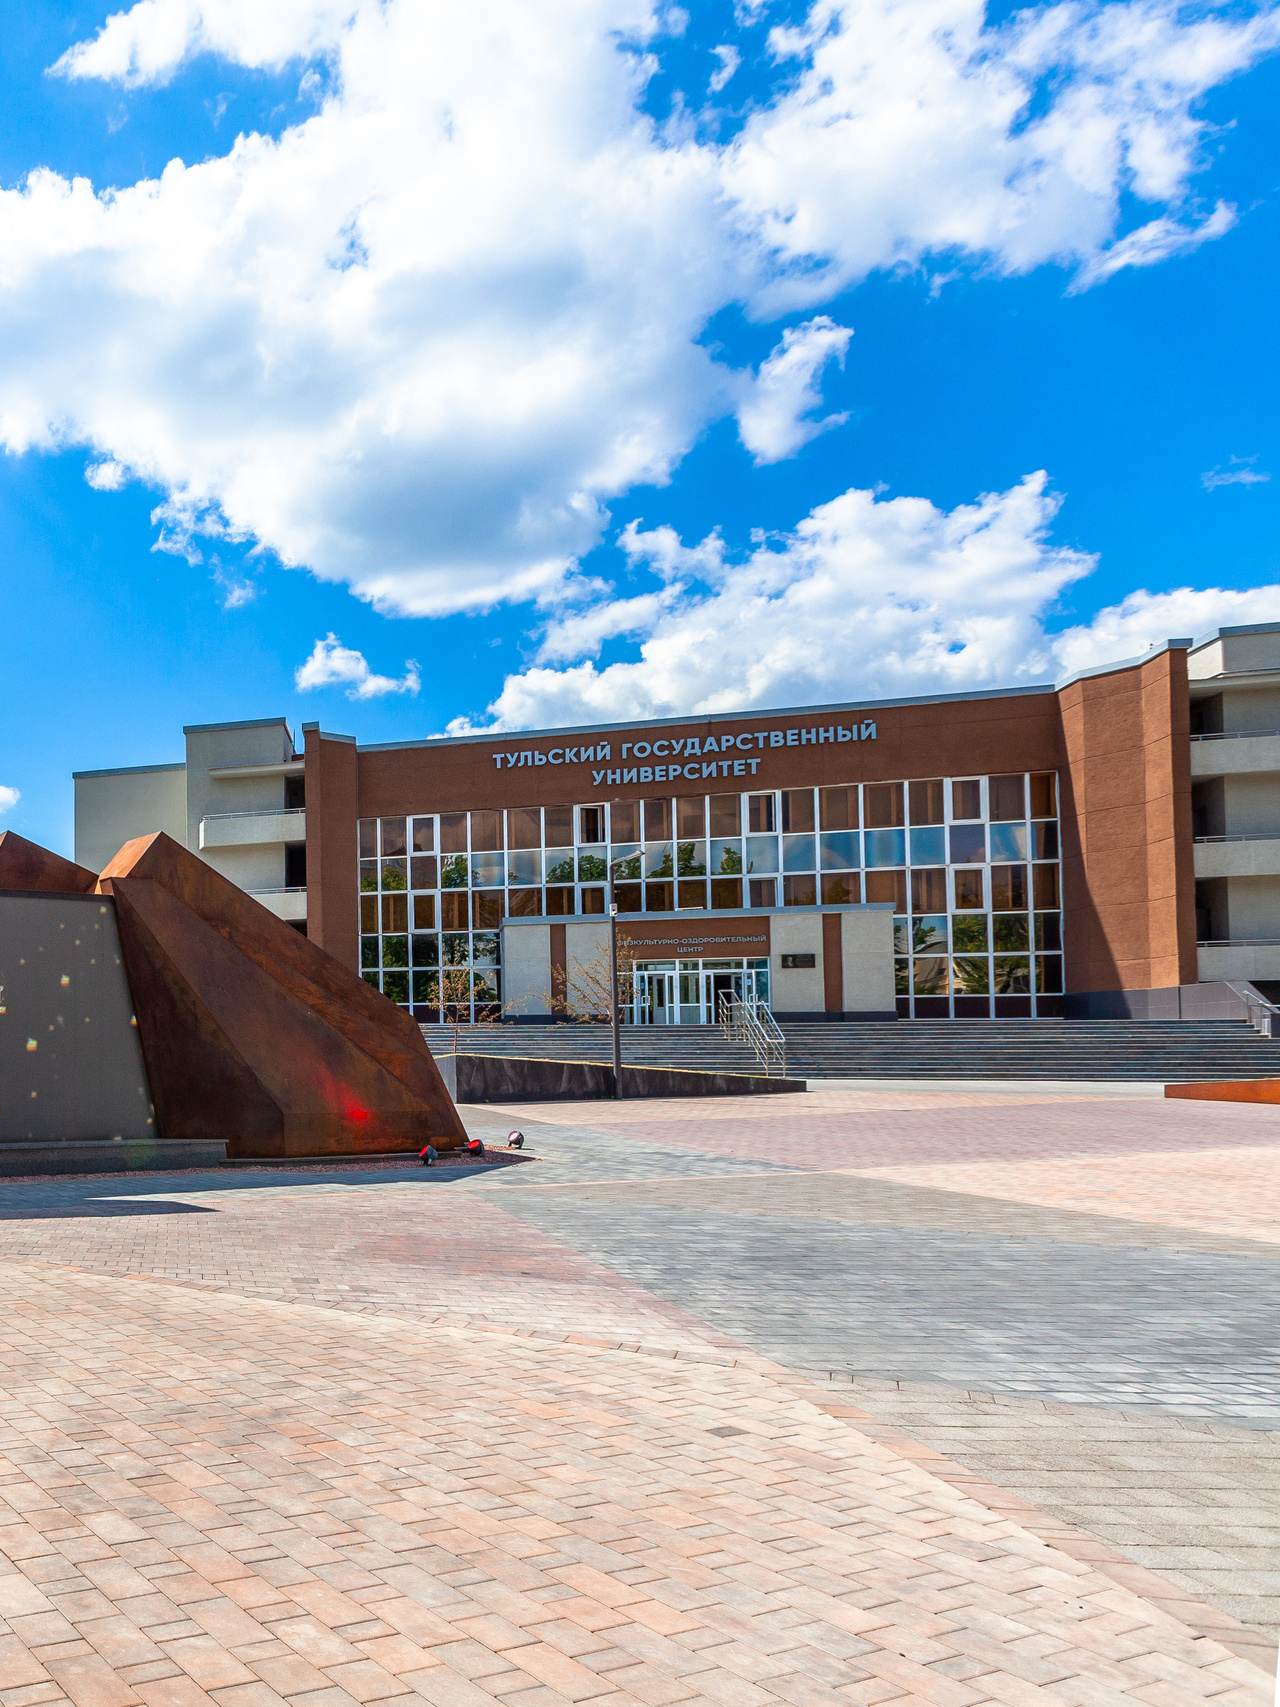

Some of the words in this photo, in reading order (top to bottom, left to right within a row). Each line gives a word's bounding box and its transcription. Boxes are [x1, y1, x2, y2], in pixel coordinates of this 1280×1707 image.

[493, 742, 611, 769] ТУЛЬСКИЙ
[621, 719, 877, 760] ГОСУДАРСТВЕННЫЙ
[592, 758, 761, 786] УНИВЕРСИТЕТ
